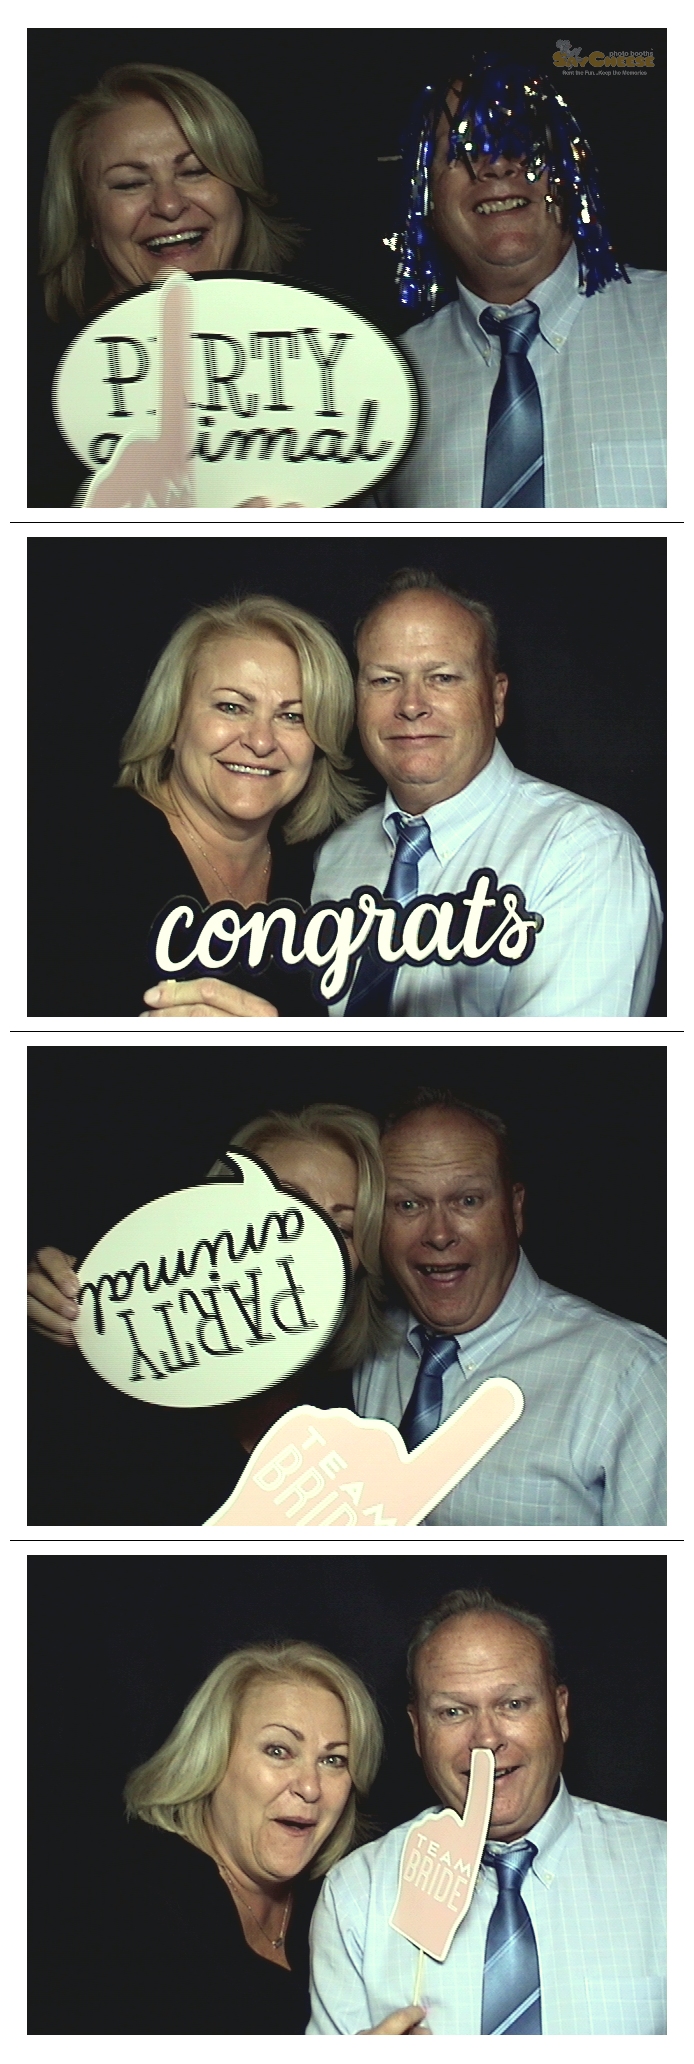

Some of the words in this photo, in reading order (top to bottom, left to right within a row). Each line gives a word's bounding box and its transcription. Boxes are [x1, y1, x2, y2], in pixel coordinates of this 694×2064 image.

[95, 327, 353, 418] PRTY
[90, 399, 394, 463] aimal
[156, 875, 537, 1000] congrats
[76, 1207, 304, 1335] animal
[116, 1255, 319, 1382] PARTY
[252, 1442, 358, 1526] BRID
[403, 1848, 468, 1911] BRIDE
[417, 1834, 471, 1877] TEAM
